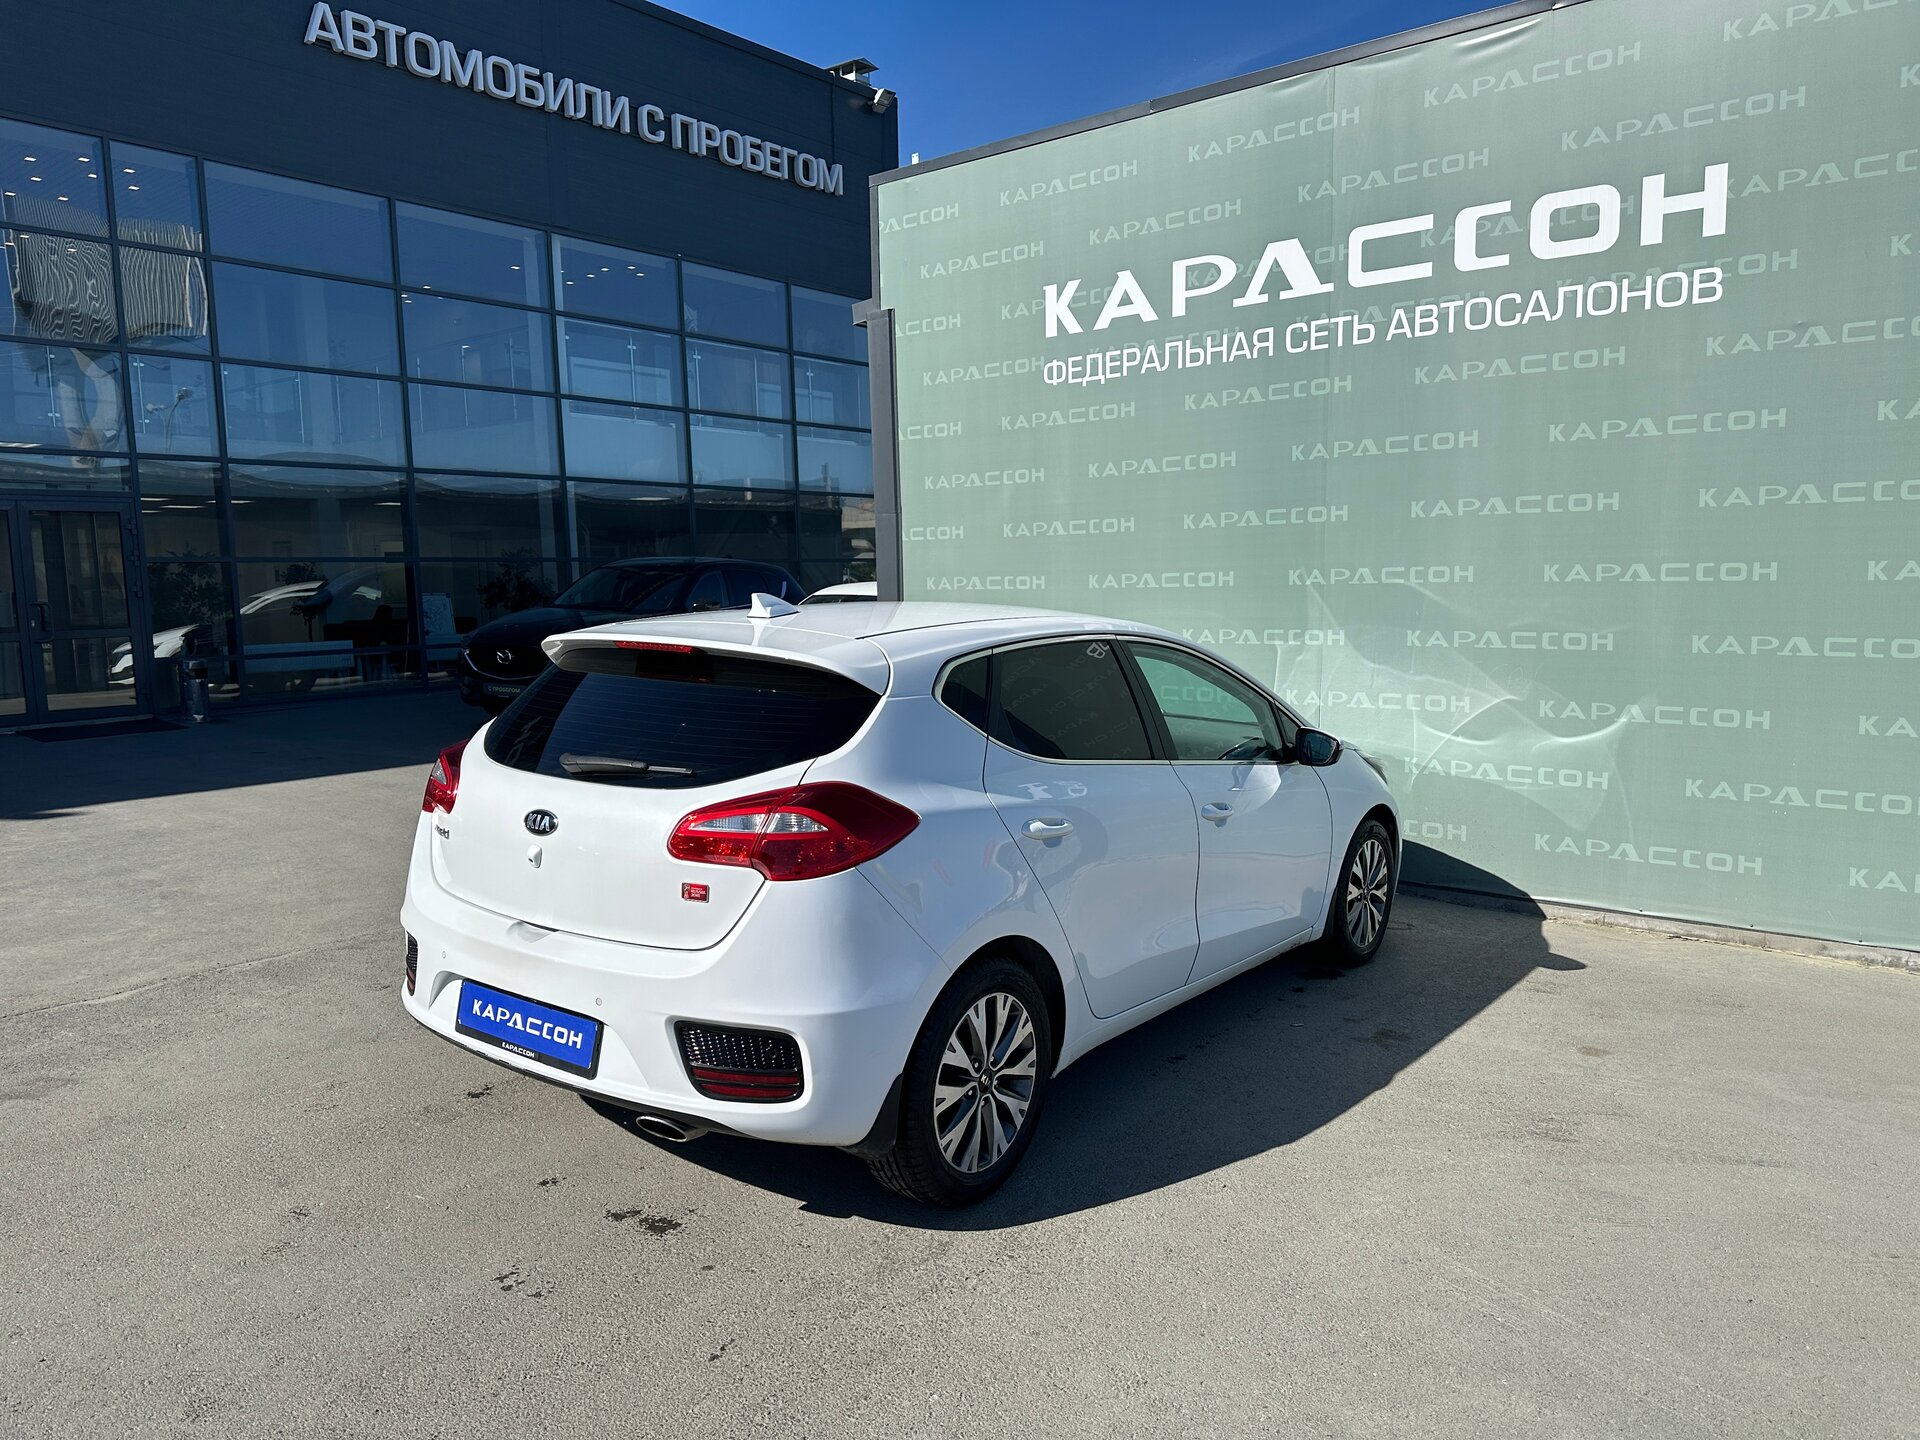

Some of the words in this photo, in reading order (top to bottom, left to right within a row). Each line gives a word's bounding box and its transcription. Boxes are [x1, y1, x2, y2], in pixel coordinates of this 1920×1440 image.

[304, 1, 630, 134] АВТОМОБИЛИ
[637, 103, 666, 144] С
[670, 113, 843, 196] ПРОБЕГОМ
[1043, 327, 1274, 387] ФЕДЕРАЛЬНАЯ
[1285, 314, 1376, 354] СЕТЬ
[1385, 266, 1724, 341] АВТОСАЛОНОВ
[527, 813, 550, 832] KIA
